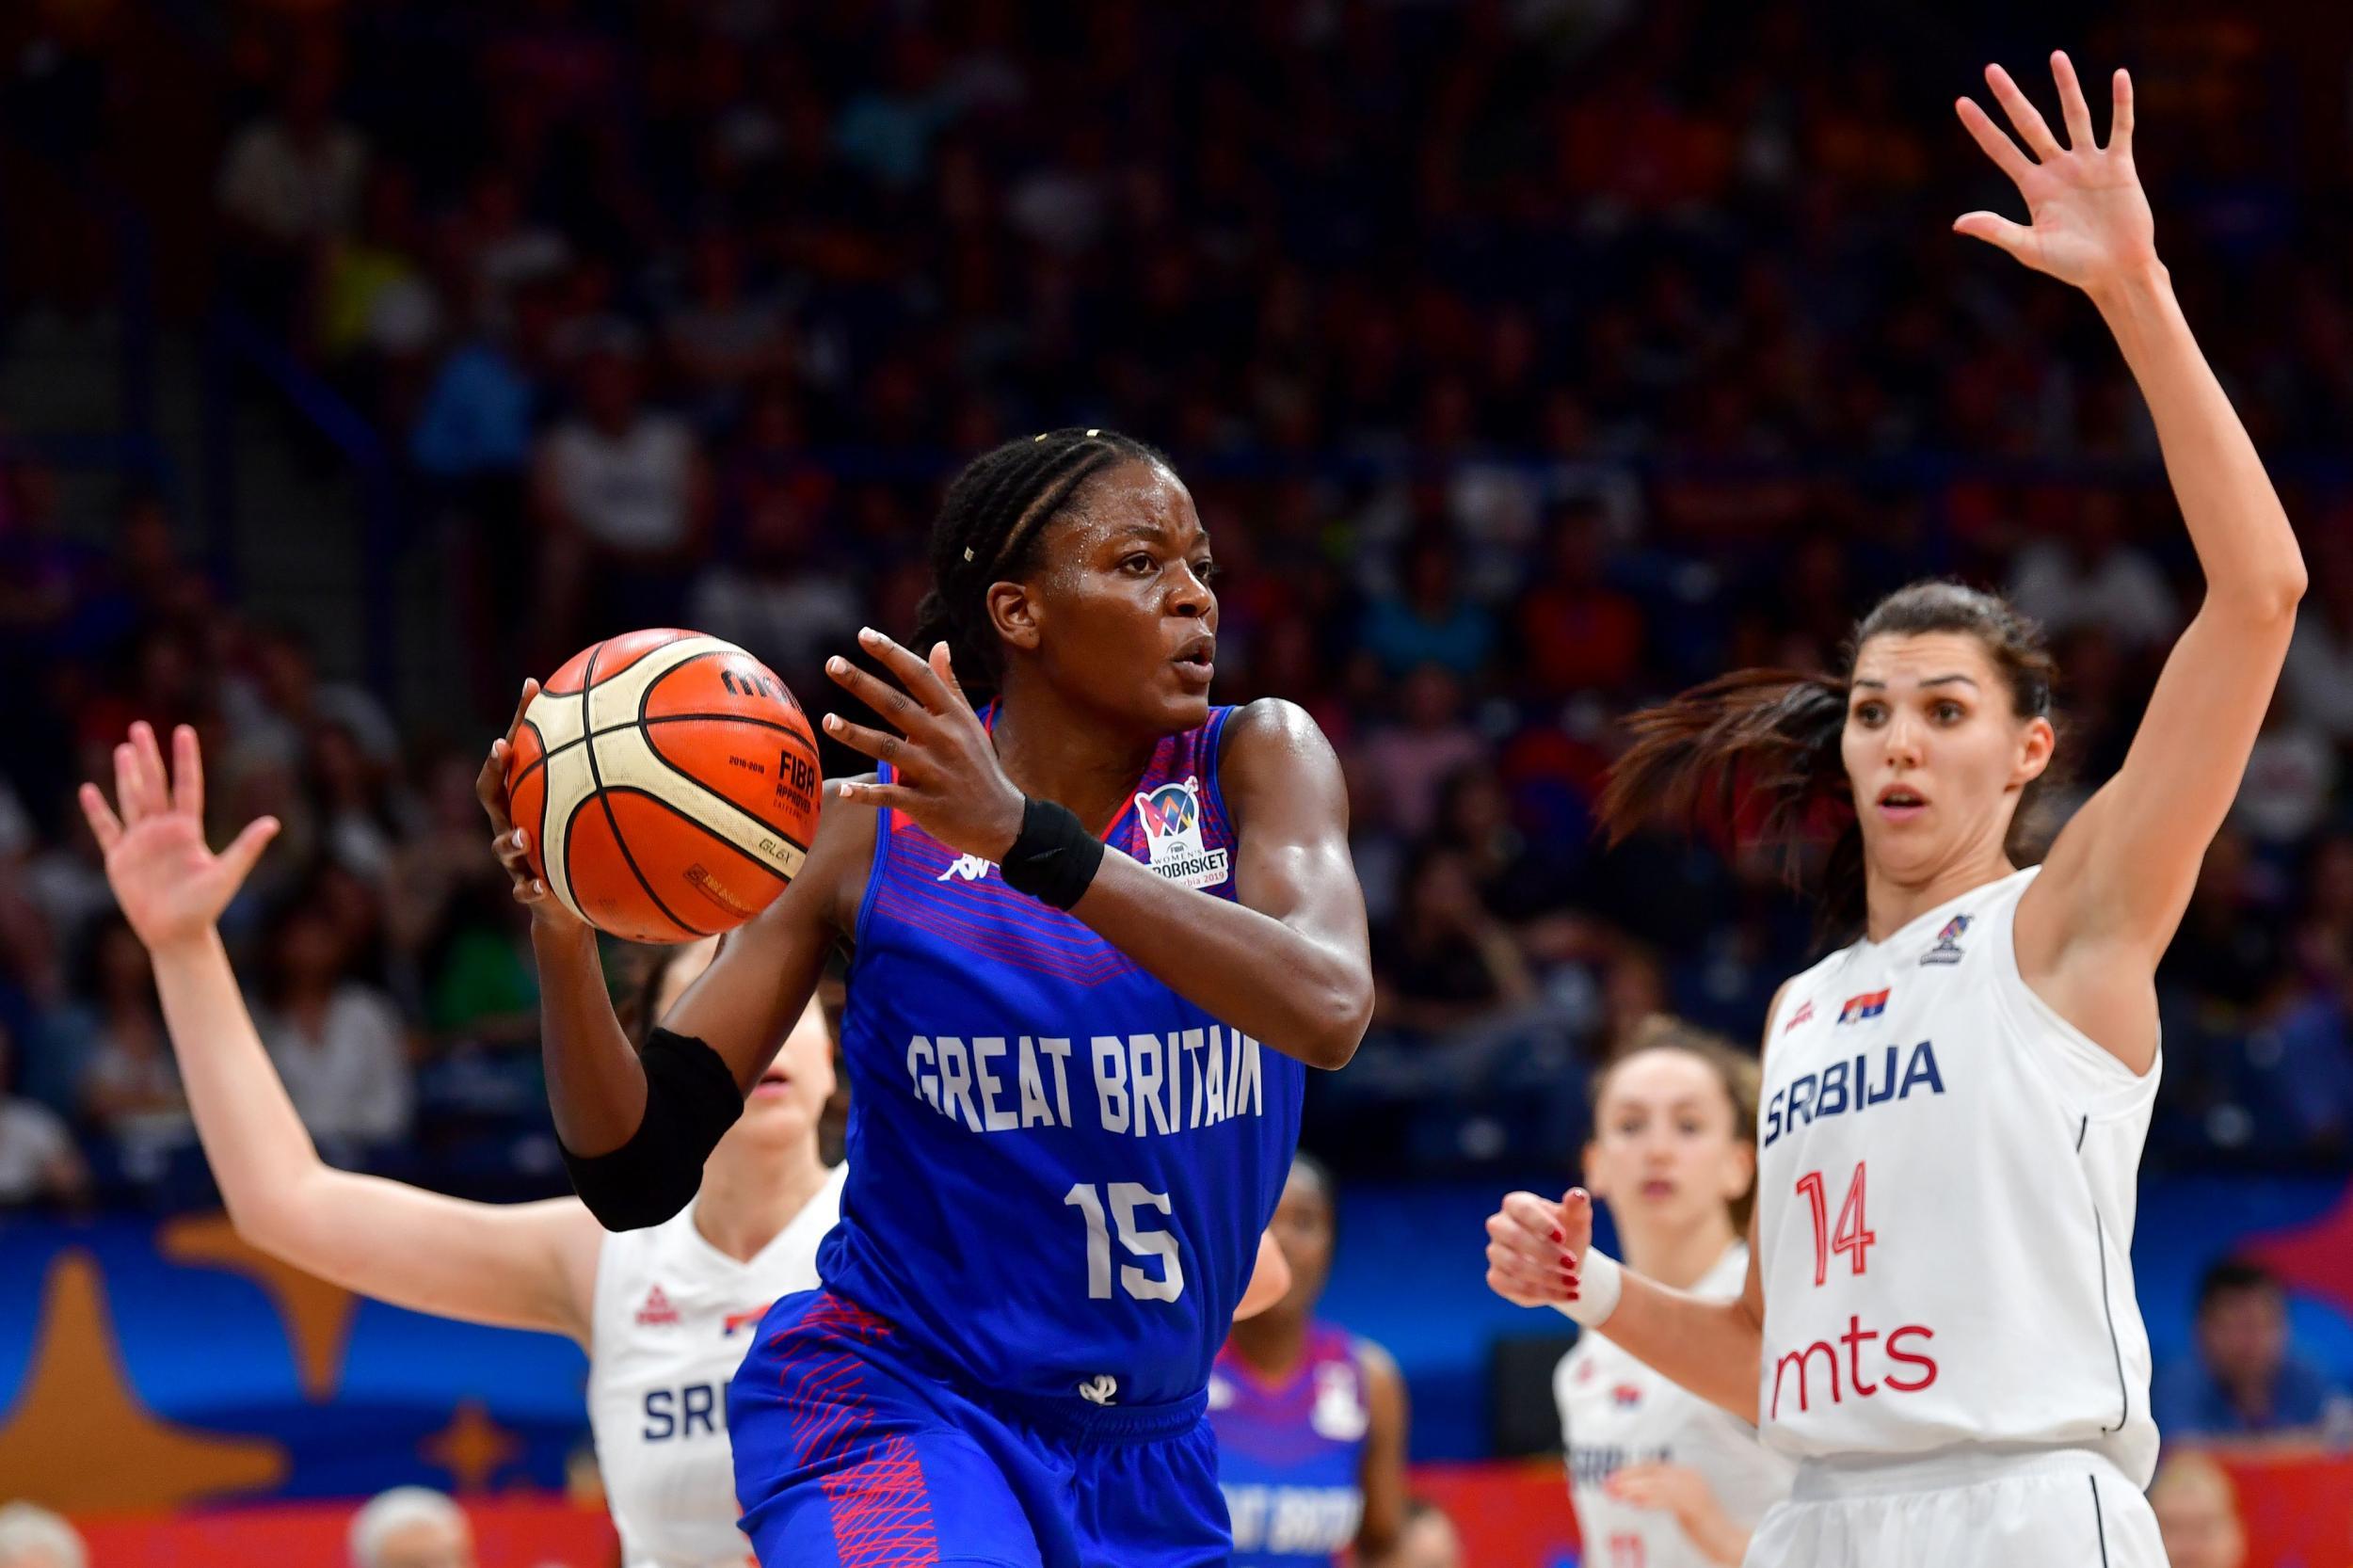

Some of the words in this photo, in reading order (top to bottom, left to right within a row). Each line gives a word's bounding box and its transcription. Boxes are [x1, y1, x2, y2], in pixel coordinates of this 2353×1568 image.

[776, 783, 811, 814] APPROVED
[779, 749, 815, 798] FIBA
[1154, 849, 1203, 865] WOMEN'S
[1204, 872, 1225, 884] 2019
[906, 1034, 1072, 1133] GREAT
[1090, 1024, 1262, 1138] BRITAIN
[1763, 1039, 1945, 1149] SRBIJA
[1064, 1182, 1185, 1304] 15
[1796, 1160, 1876, 1288] 14
[1770, 1315, 1939, 1422] mts
[642, 1381, 731, 1441] SR
